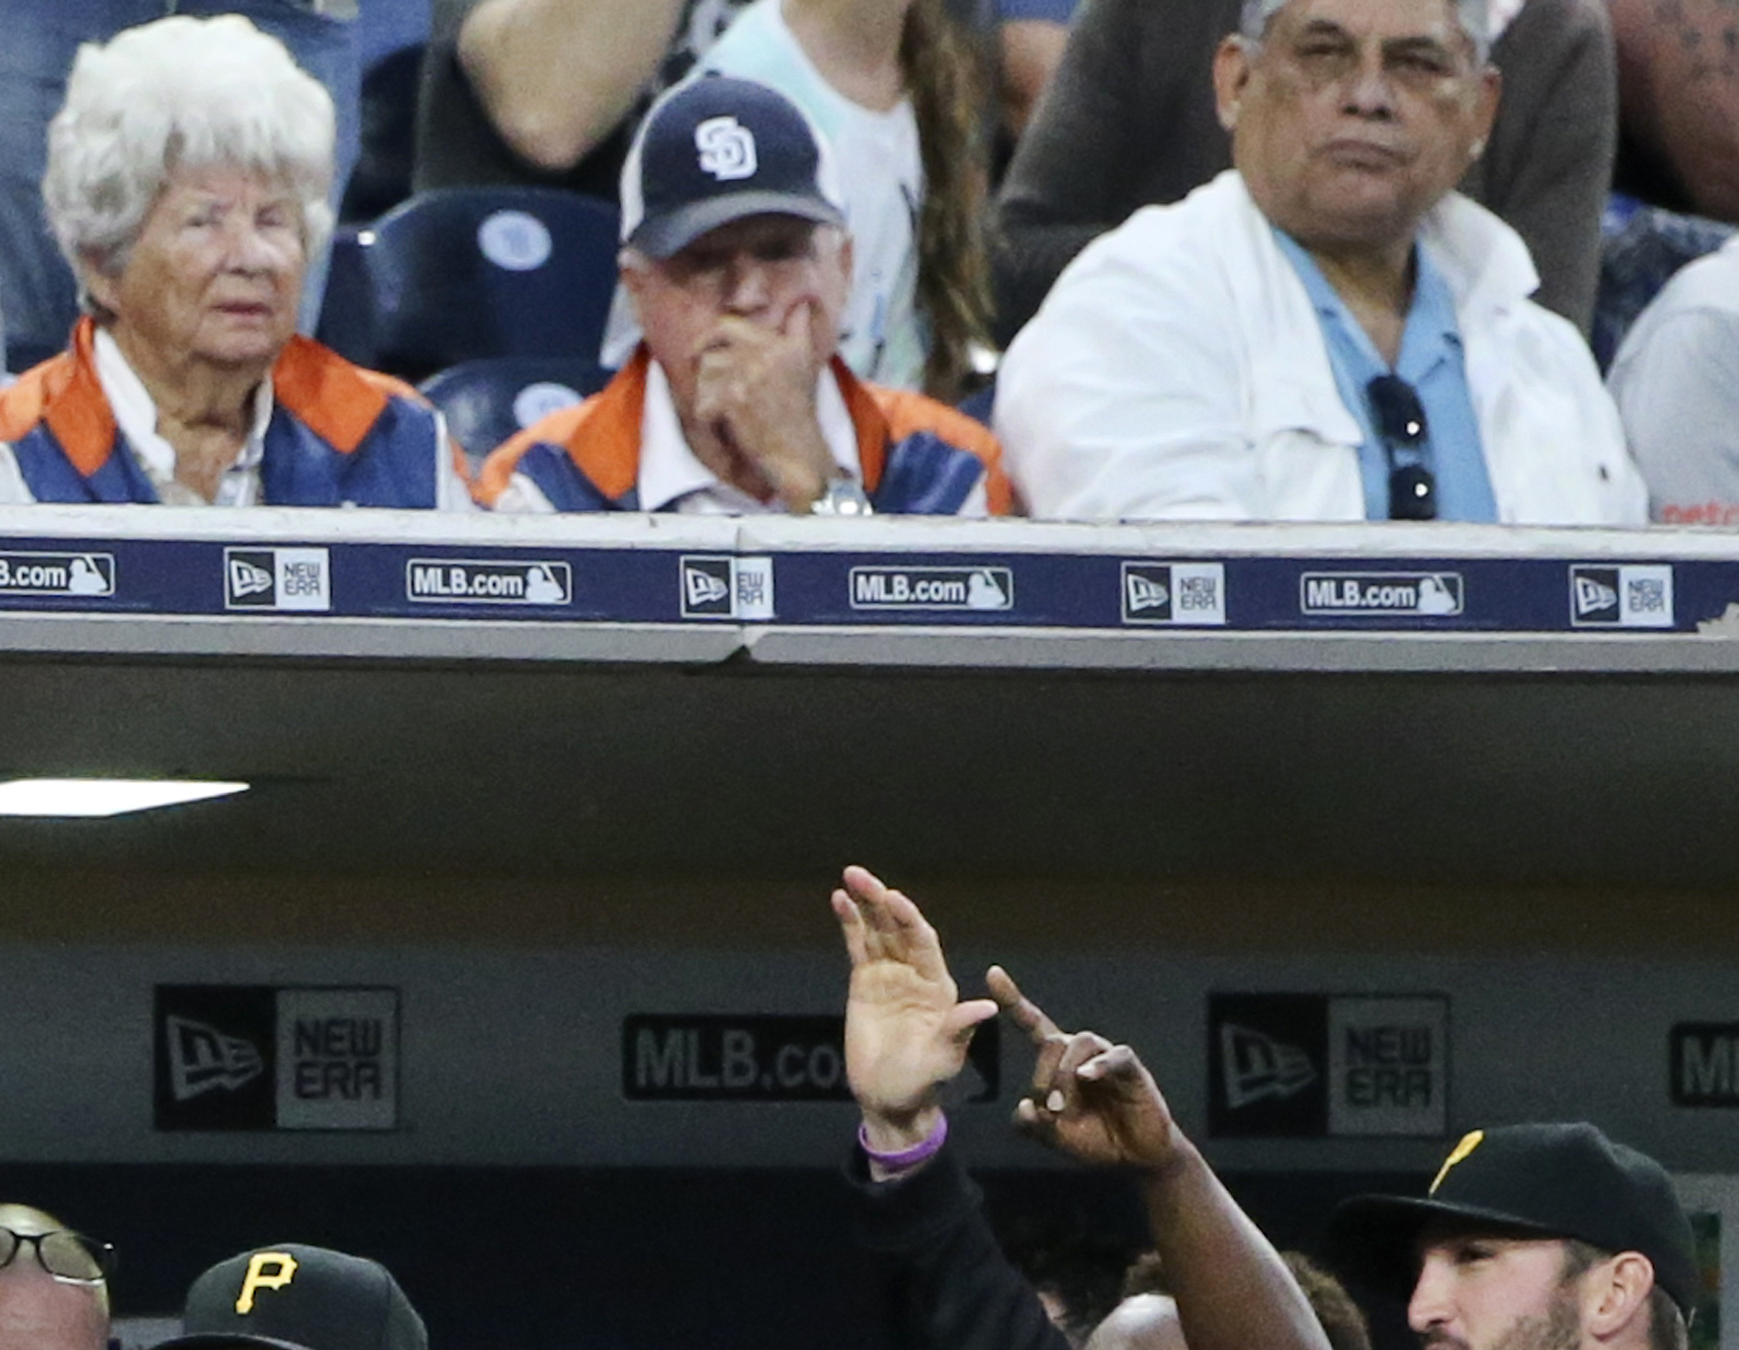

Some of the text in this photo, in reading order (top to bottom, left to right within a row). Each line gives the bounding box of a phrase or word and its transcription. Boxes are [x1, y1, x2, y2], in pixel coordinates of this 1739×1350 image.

[284, 562, 321, 578] NEW
[414, 568, 522, 595] MLB.com
[284, 579, 321, 596] ERA
[856, 576, 965, 602] MLB.com
[1181, 578, 1217, 592] NEW
[1308, 581, 1415, 606] MLB.com
[1181, 594, 1217, 610] ERA
[295, 1017, 382, 1057] NEW
[1347, 1025, 1432, 1063] NEW
[635, 1028, 846, 1088] MLB.co
[295, 1060, 382, 1099] ERA
[1347, 1067, 1432, 1107] ERA
[235, 1252, 298, 1314] P
